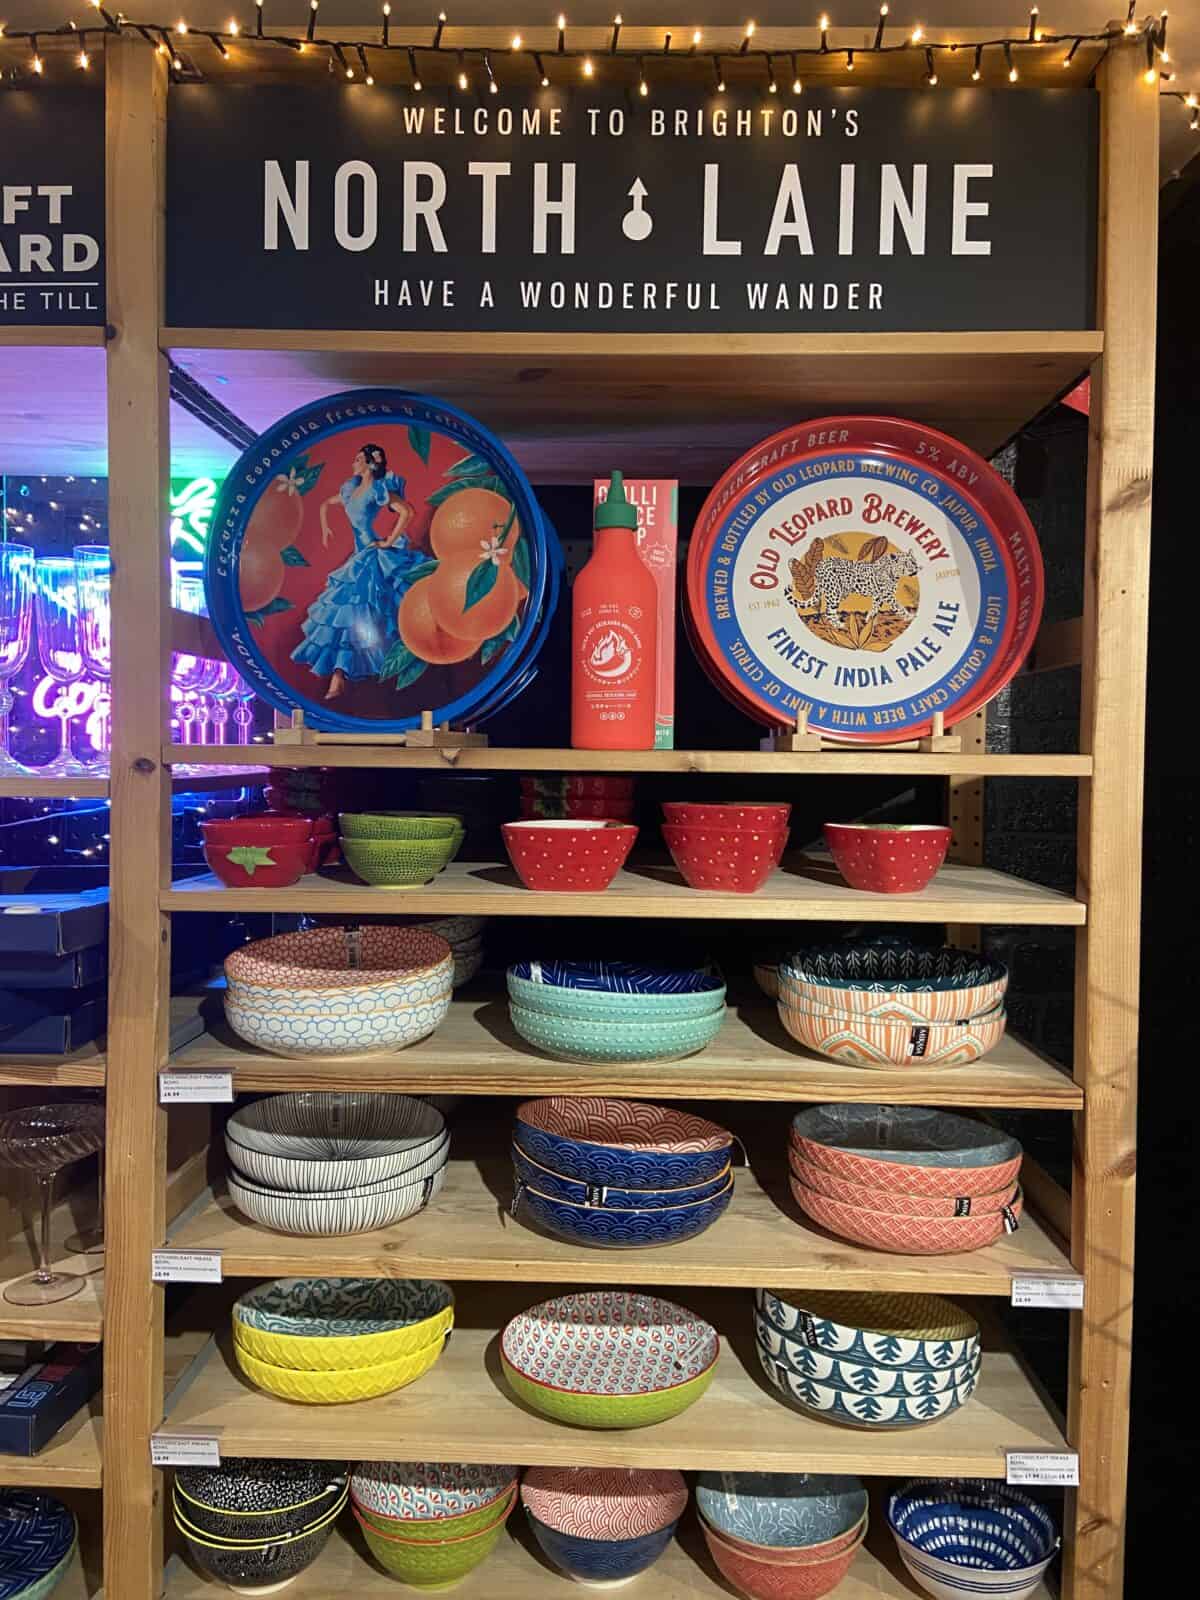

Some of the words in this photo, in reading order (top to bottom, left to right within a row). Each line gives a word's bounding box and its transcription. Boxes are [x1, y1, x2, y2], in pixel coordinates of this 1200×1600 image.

[403, 107, 562, 136] WELCOME
[587, 109, 625, 137] TO
[651, 109, 860, 138] BRIGHTON'S
[263, 160, 577, 255] NORTH
[703, 163, 994, 256] LAINE
[40, 291, 98, 310] TILL
[374, 279, 455, 308] HAVE
[479, 281, 495, 308] A
[521, 281, 721, 311] WONDERFUL
[747, 283, 885, 311] WANDER
[806, 428, 850, 448] BEER
[799, 459, 856, 482] LEOPARD
[860, 461, 921, 486] BREWING
[915, 441, 942, 463] 5%
[945, 458, 980, 487] ABV
[772, 472, 798, 494] OLD
[920, 478, 941, 500] CO.
[754, 487, 773, 507] BY
[720, 503, 759, 553] BOTTLED
[749, 547, 782, 591] OLD
[767, 496, 855, 547] LEOPARD
[861, 492, 951, 562] BREWERY
[717, 554, 733, 567] &
[713, 568, 732, 621] BREWED
[983, 595, 1003, 634] LIGHT
[767, 626, 828, 681] FINEST
[833, 664, 894, 690] INDIA
[895, 636, 943, 678] PALE
[931, 600, 961, 638] ALE
[976, 634, 994, 647] &
[728, 636, 766, 683] CITRUS.
[948, 647, 988, 694] GOLDEN
[760, 679, 783, 698] OF
[816, 705, 829, 720] A
[910, 687, 950, 717] CRAFT
[831, 709, 867, 728] WITH
[872, 707, 907, 726] BEER
